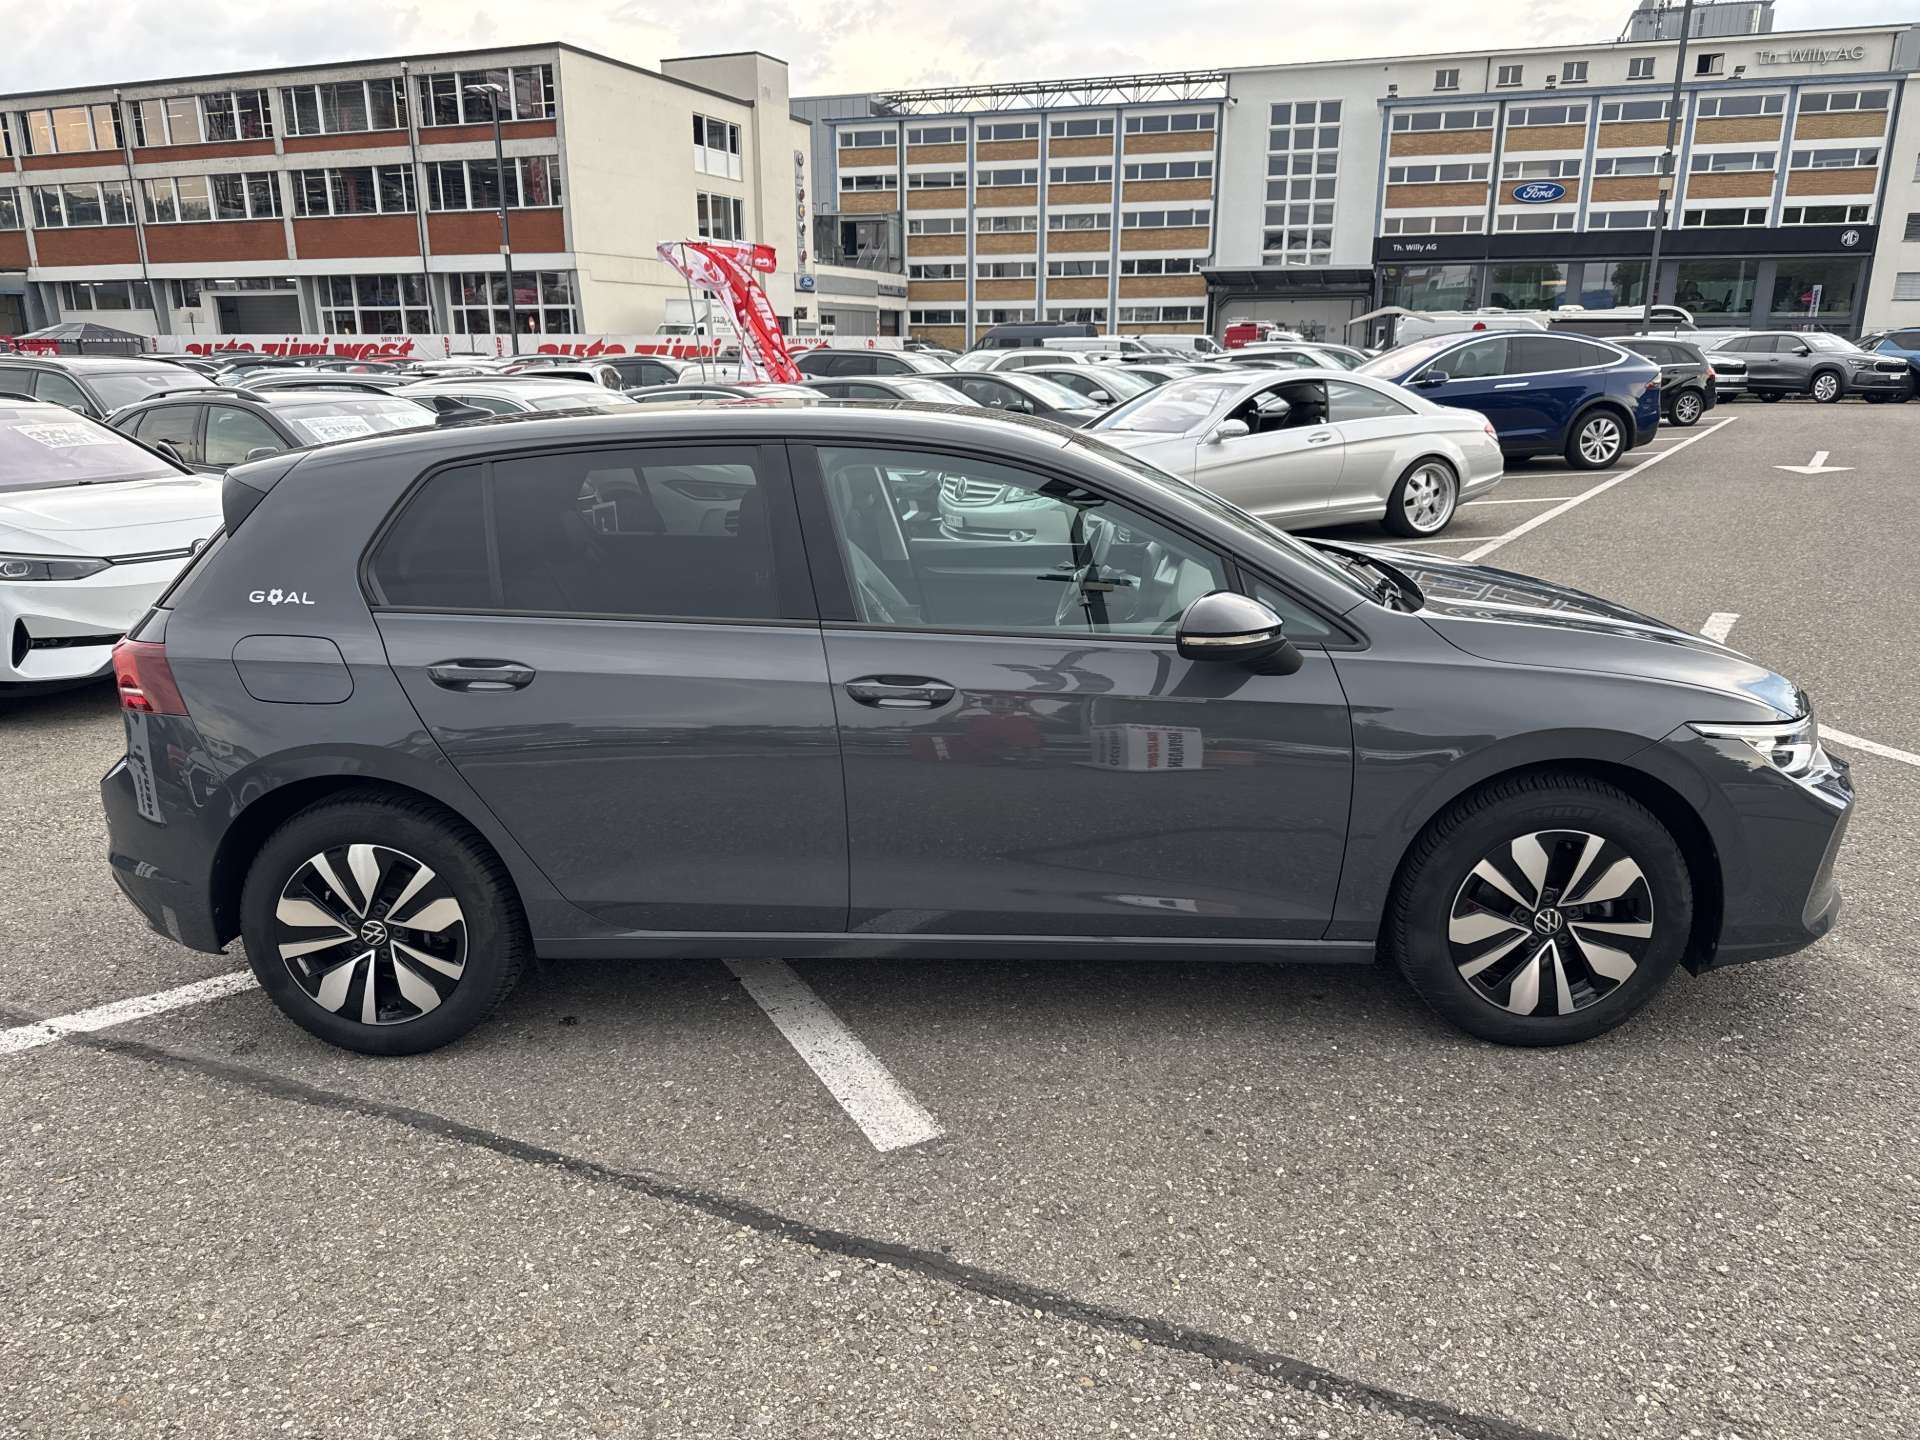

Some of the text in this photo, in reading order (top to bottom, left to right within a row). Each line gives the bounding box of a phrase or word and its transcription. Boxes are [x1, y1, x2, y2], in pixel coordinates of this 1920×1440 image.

[1789, 47, 1832, 65] Willy
[1837, 45, 1866, 61] AG
[1520, 184, 1557, 200] Ford
[1842, 230, 1859, 246] MG
[1406, 243, 1425, 253] Willy
[1426, 243, 1438, 251] AG
[787, 337, 823, 345] SEIT 1991
[248, 588, 316, 606] GOAL
